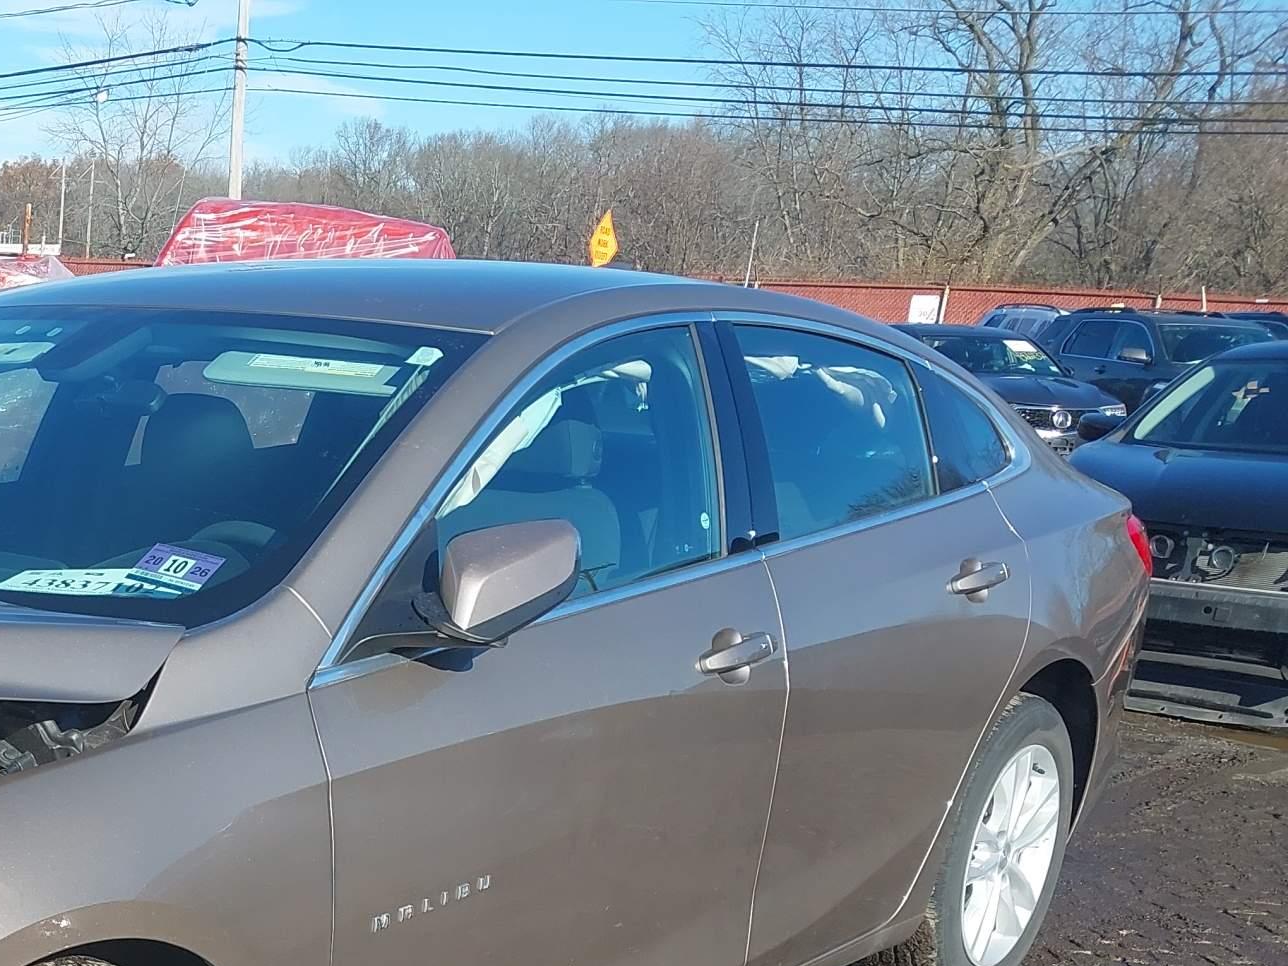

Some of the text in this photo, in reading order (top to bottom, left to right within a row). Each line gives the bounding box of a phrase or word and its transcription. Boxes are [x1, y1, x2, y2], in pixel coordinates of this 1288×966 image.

[144, 555, 211, 577] 20 10 26
[371, 874, 492, 932] MALIBU
